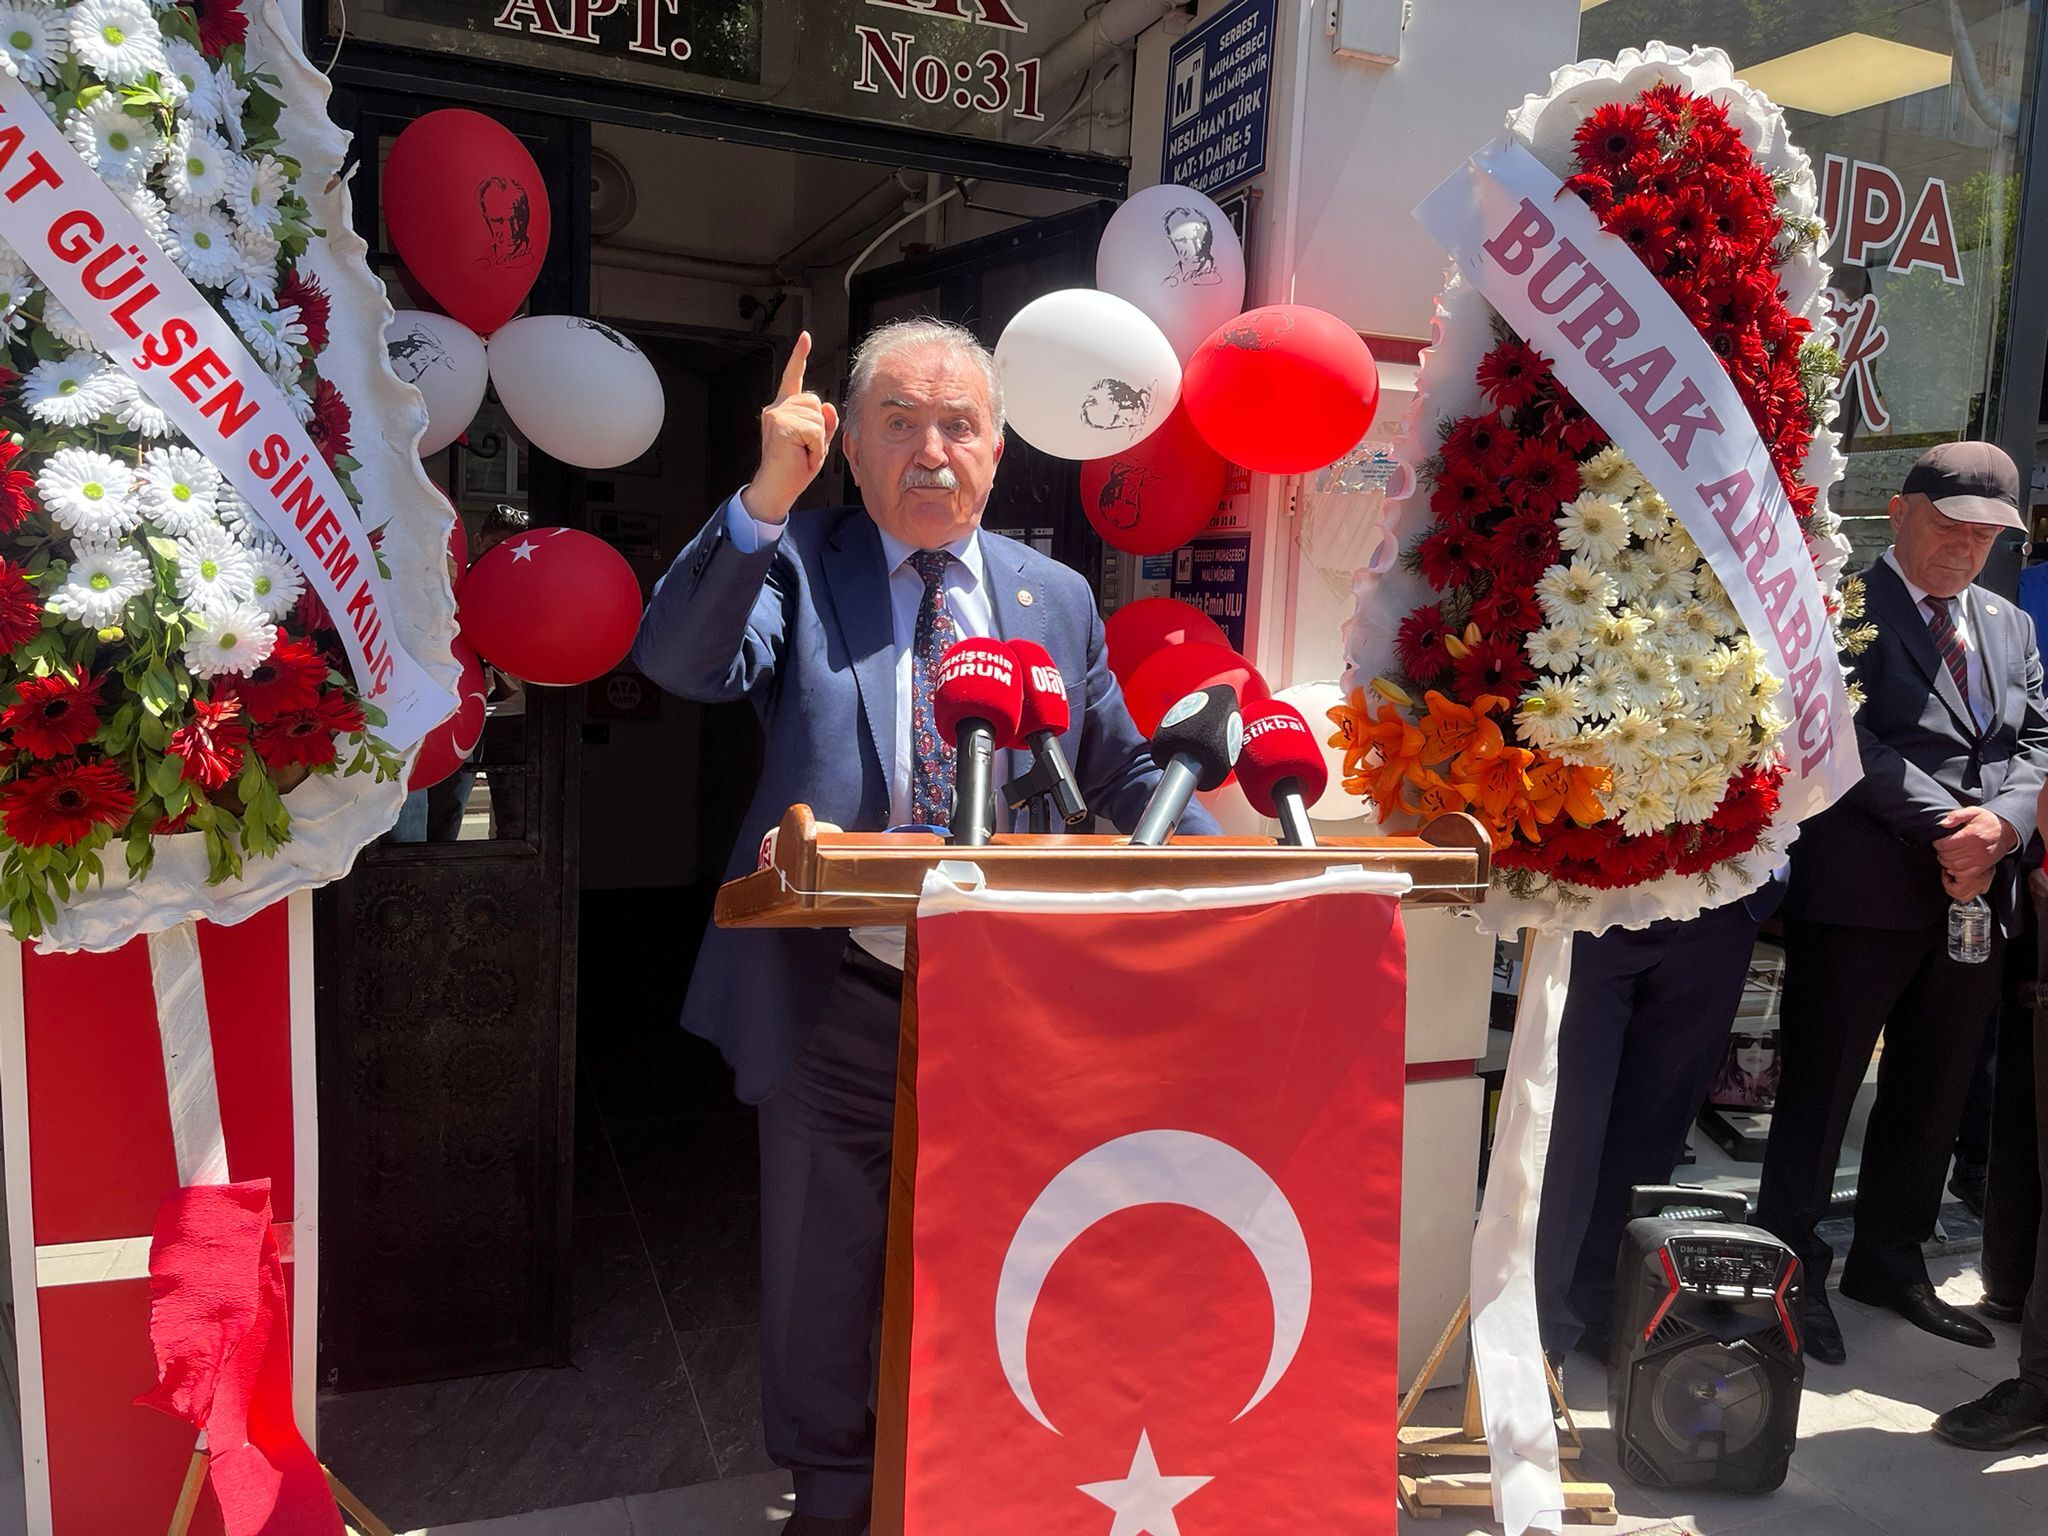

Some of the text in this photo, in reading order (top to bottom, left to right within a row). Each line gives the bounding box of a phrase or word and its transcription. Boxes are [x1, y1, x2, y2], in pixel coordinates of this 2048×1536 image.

[1209, 25, 1267, 81] MUHASEBECİ
[1219, 11, 1260, 52] SERBEST
[853, 25, 1045, 122] No:31
[1204, 53, 1267, 106] MALİ MÜŞAVİR
[1169, 87, 1262, 160] NESLİHAN TÜRK
[1173, 157, 1197, 184] KAT:
[1205, 130, 1242, 168] DAİRE:
[1244, 124, 1251, 146] 5
[0, 104, 396, 699] AT GÜLŞEN SİNEM KILIÇ
[1482, 198, 1835, 780] BURAK ARABACI
[1204, 592, 1224, 616] Emin
[1225, 592, 1243, 617] ULU
[609, 680, 638, 694] ATA
[936, 662, 1012, 692] DURUM
[1240, 717, 1306, 749] stikbal
